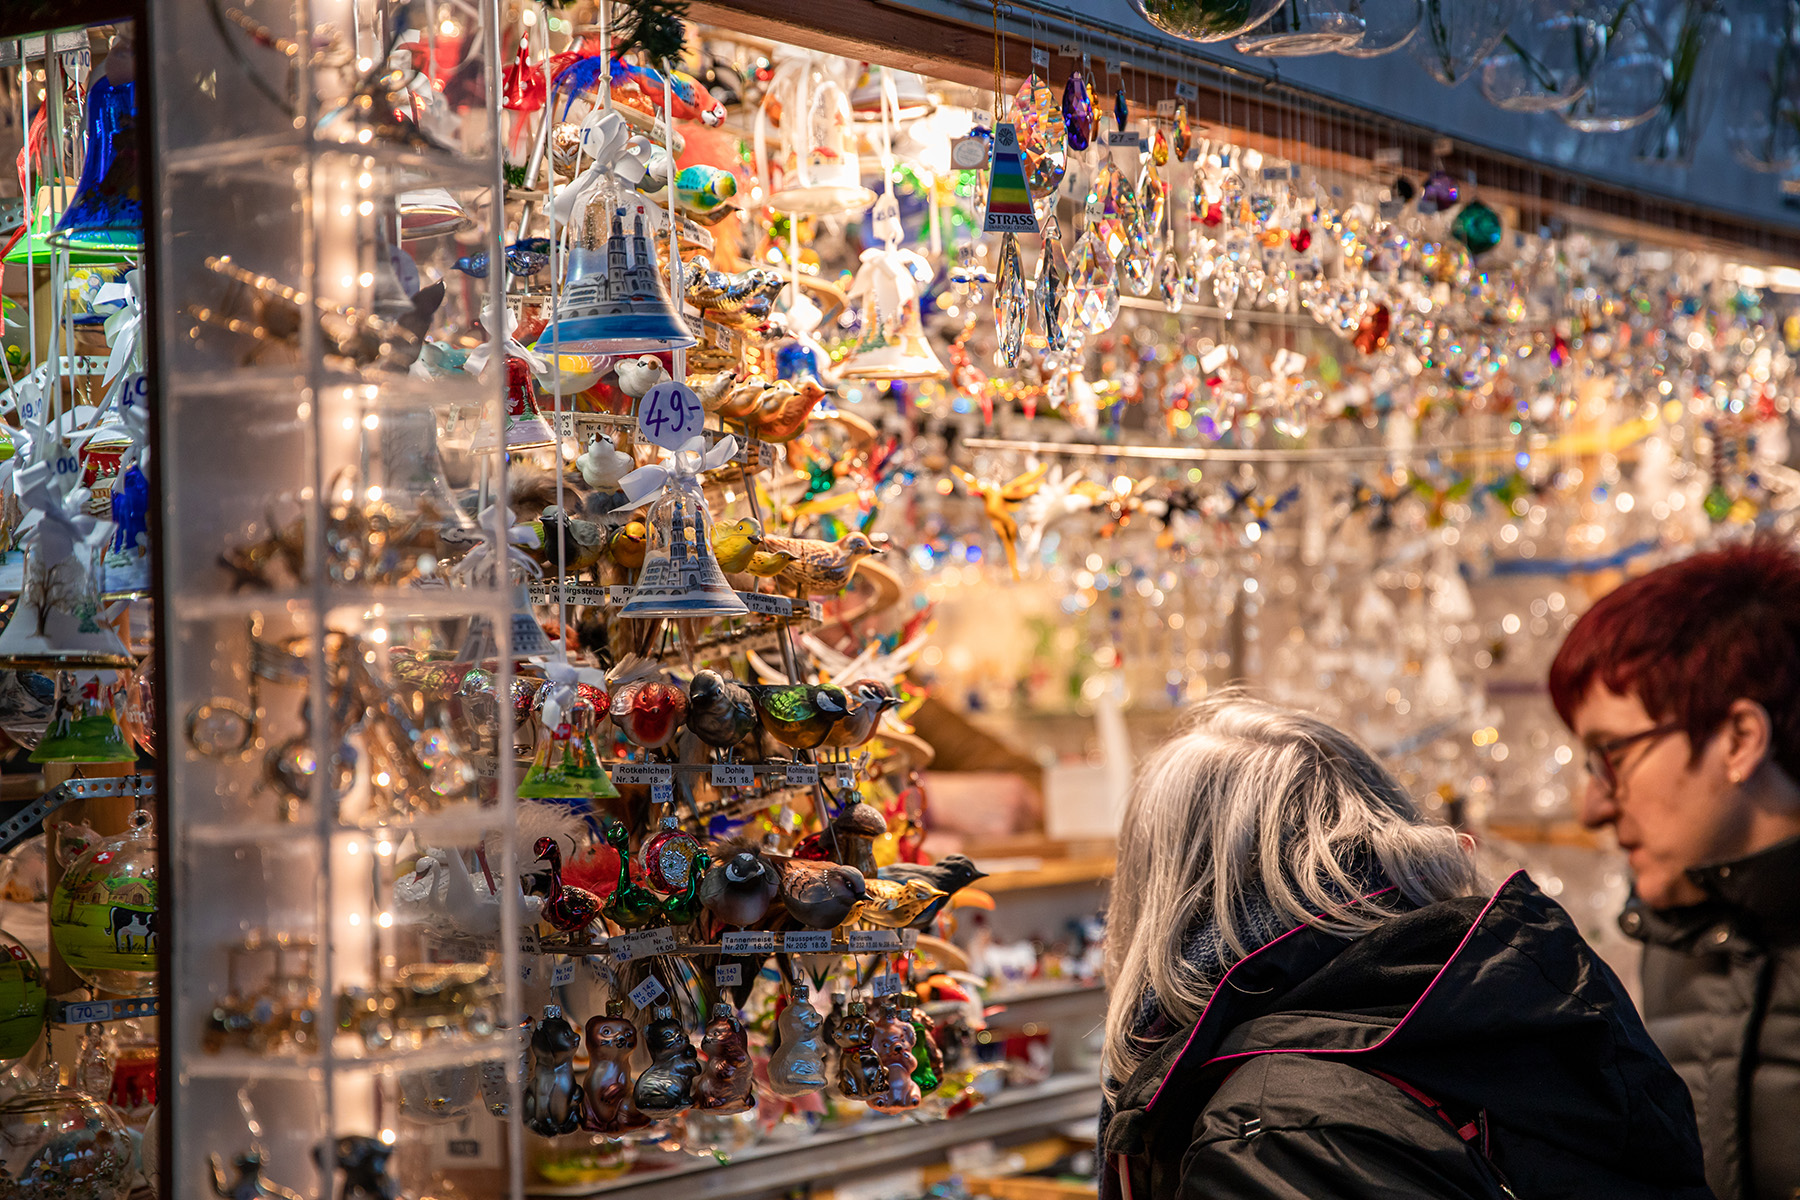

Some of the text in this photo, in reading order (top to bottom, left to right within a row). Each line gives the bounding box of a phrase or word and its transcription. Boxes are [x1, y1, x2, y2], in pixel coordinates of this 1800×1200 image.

[1060, 44, 1078, 53] 14.-
[1110, 134, 1136, 143] 27.-
[988, 213, 1034, 226] STRASS
[645, 389, 700, 437] 49.-
[620, 766, 670, 775] Rotkehlchen
[725, 766, 745, 774] Dohle
[616, 775, 628, 783] Nr.
[649, 776, 663, 784] 18.-
[640, 931, 657, 939] Grün
[786, 935, 826, 943] Haussperling
[725, 936, 772, 944] Tannenmeise
[753, 942, 772, 950] 18.00
[811, 941, 828, 949] 18.00
[717, 975, 734, 983] 12.00
[638, 989, 657, 1004] 12.00
[76, 1006, 104, 1018] 70.-
